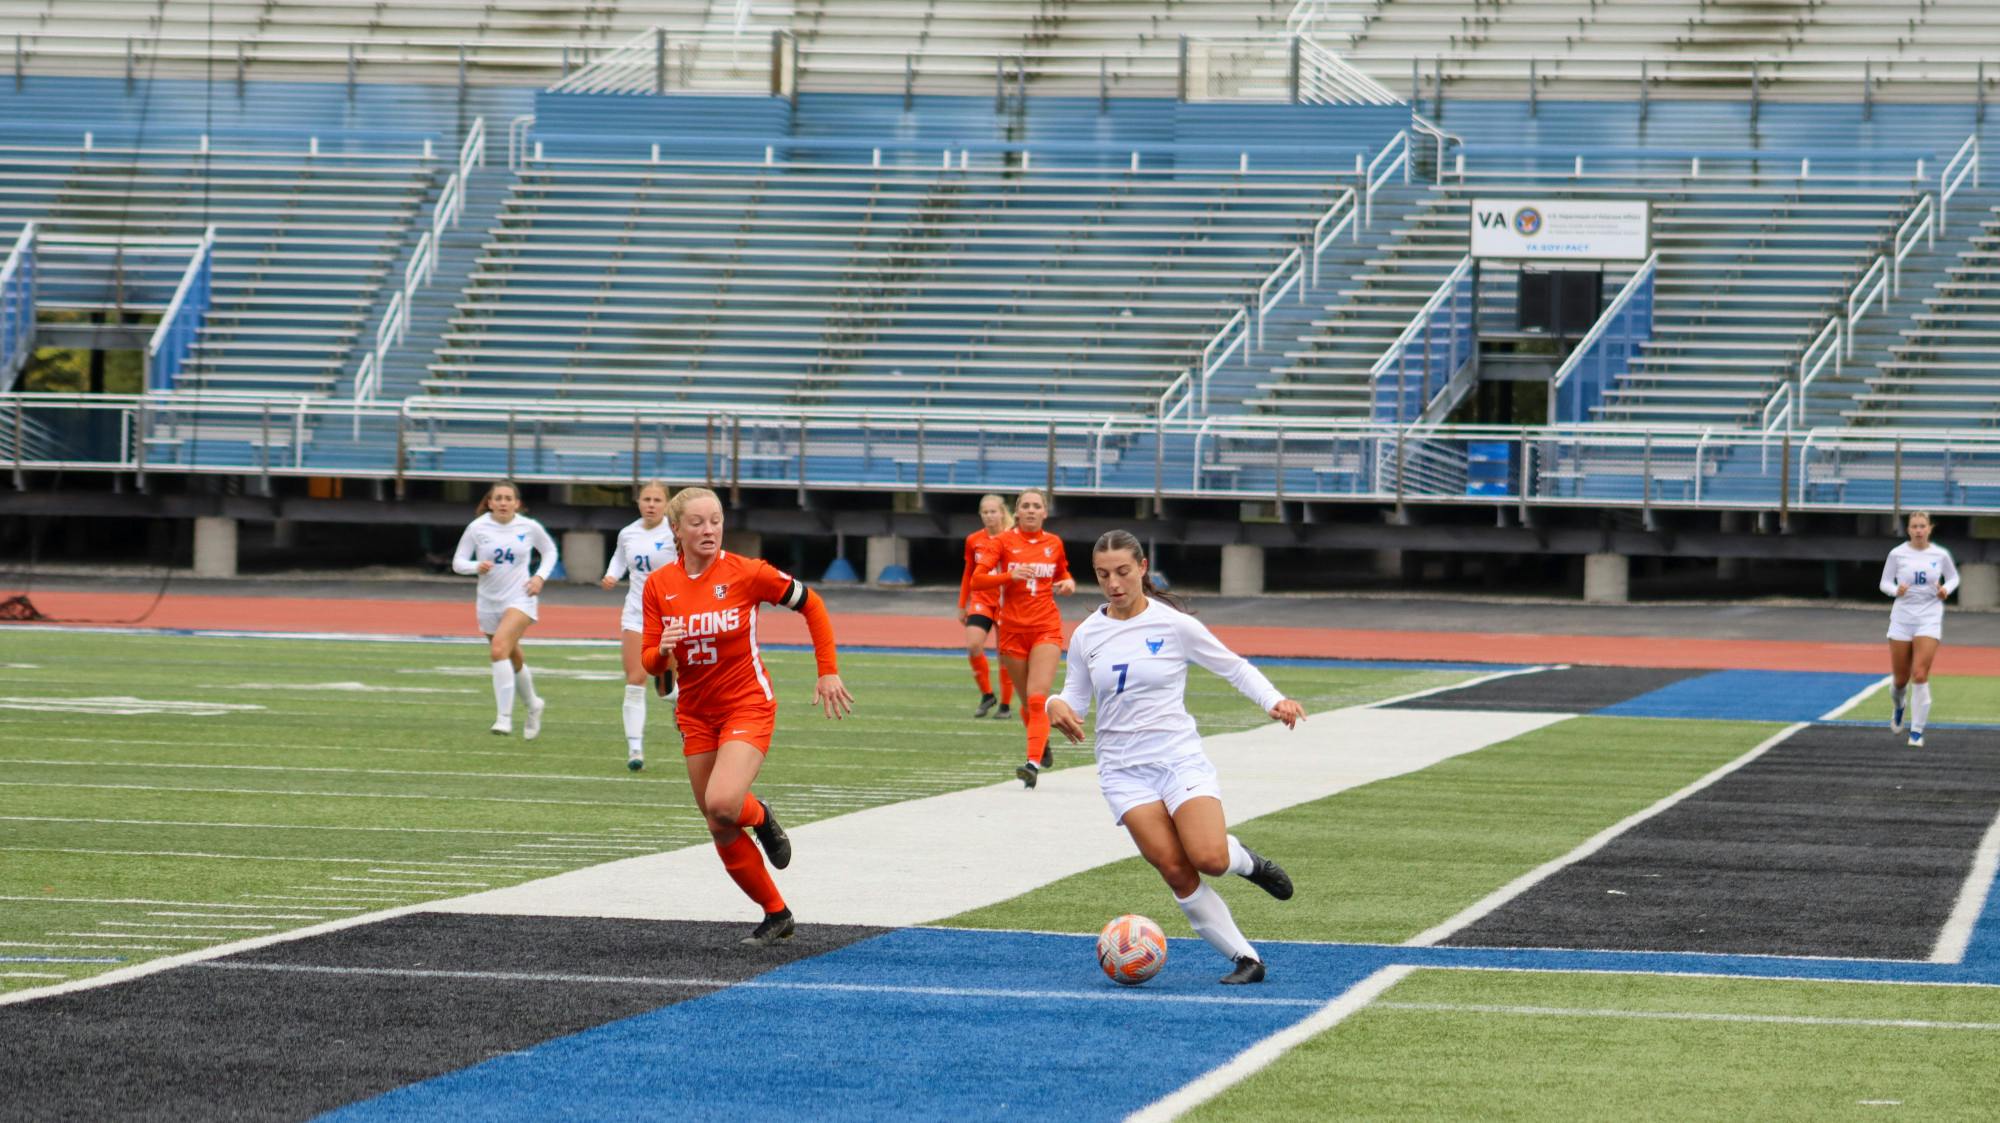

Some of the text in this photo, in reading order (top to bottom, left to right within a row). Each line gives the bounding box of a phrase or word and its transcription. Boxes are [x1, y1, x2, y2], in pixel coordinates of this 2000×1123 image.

[1478, 212, 1507, 228] VA
[494, 548, 514, 564] 24
[635, 555, 651, 571] 21
[1914, 571, 1927, 585] 16
[683, 637, 718, 665] 25
[1112, 664, 1128, 695] 7
